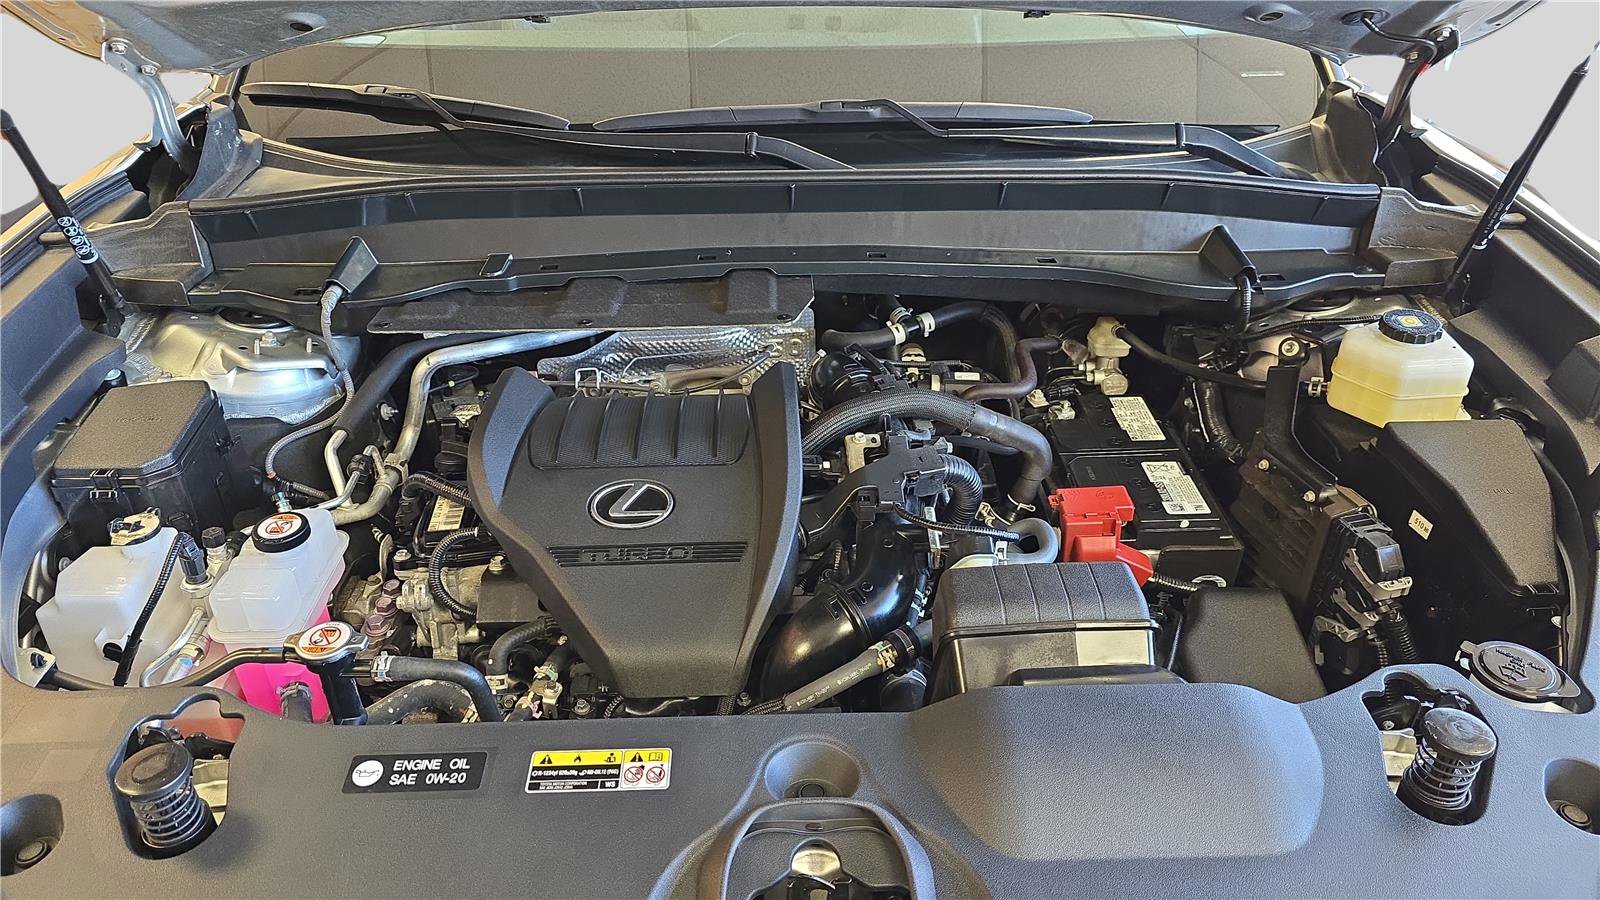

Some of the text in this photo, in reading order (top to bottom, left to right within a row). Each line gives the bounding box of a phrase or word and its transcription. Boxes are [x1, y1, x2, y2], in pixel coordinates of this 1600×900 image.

[581, 545, 692, 562] TURBO
[392, 757, 471, 771] ENGINE OIL
[388, 772, 467, 786] SAE 0W-20
[605, 780, 616, 788] WS
